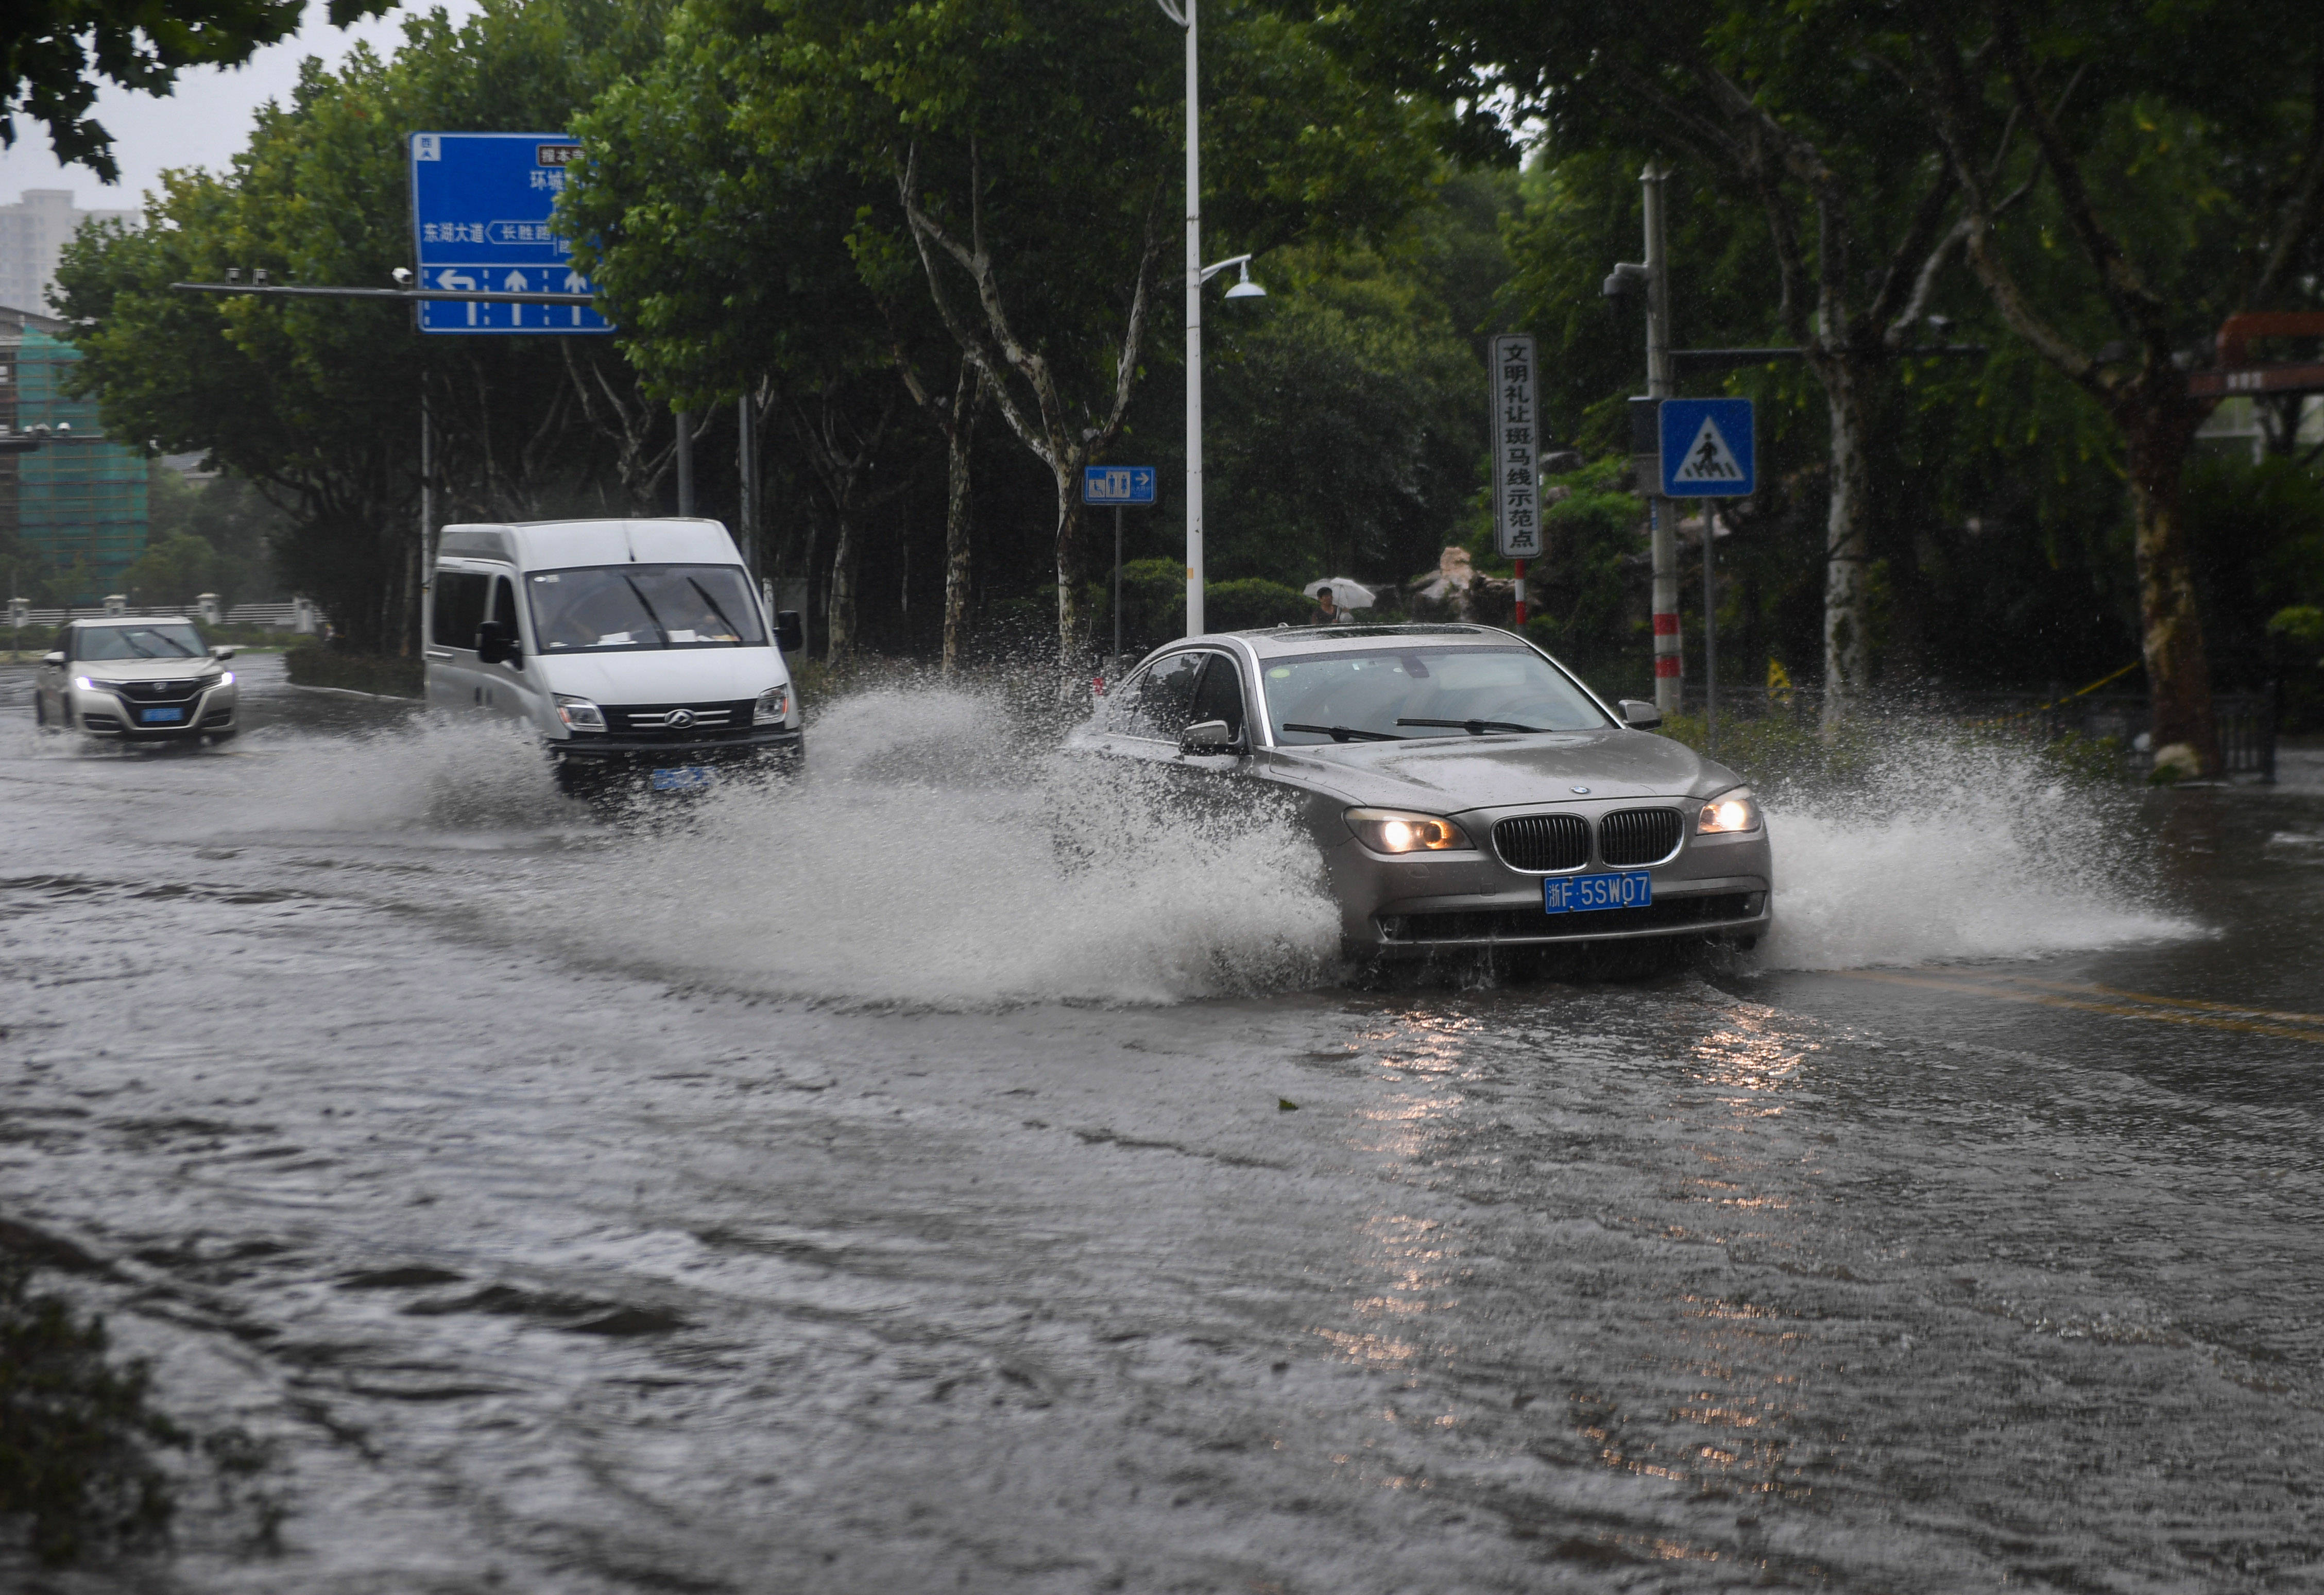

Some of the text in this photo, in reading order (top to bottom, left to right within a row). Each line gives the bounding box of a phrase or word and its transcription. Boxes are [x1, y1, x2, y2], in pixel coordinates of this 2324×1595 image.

[423, 223, 485, 243] 东湖大道
[501, 224, 552, 241] 长胜路
[1503, 344, 1534, 549] 文明礼让斑马线示范点
